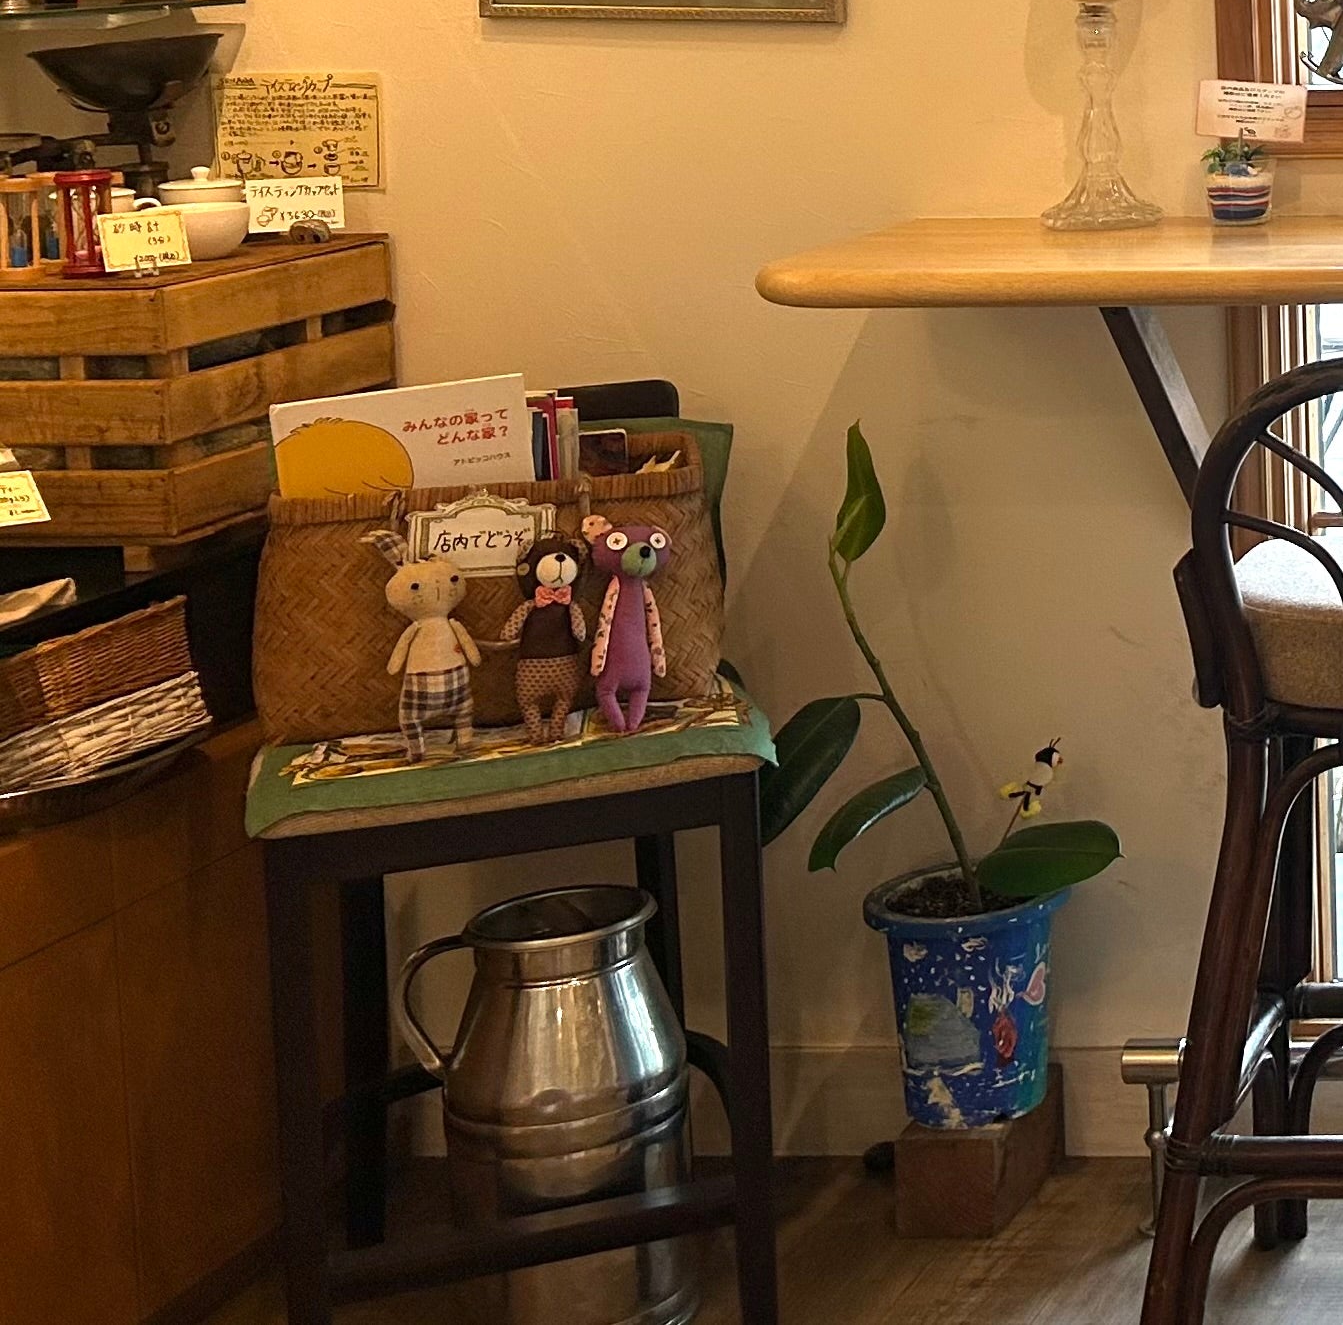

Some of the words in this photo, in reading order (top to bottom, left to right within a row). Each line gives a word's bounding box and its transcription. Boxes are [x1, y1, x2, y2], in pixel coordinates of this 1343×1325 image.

[402, 407, 509, 433] みんなの家って
[436, 426, 509, 446] どんな家？
[433, 529, 531, 553] 店内でどうぞ
